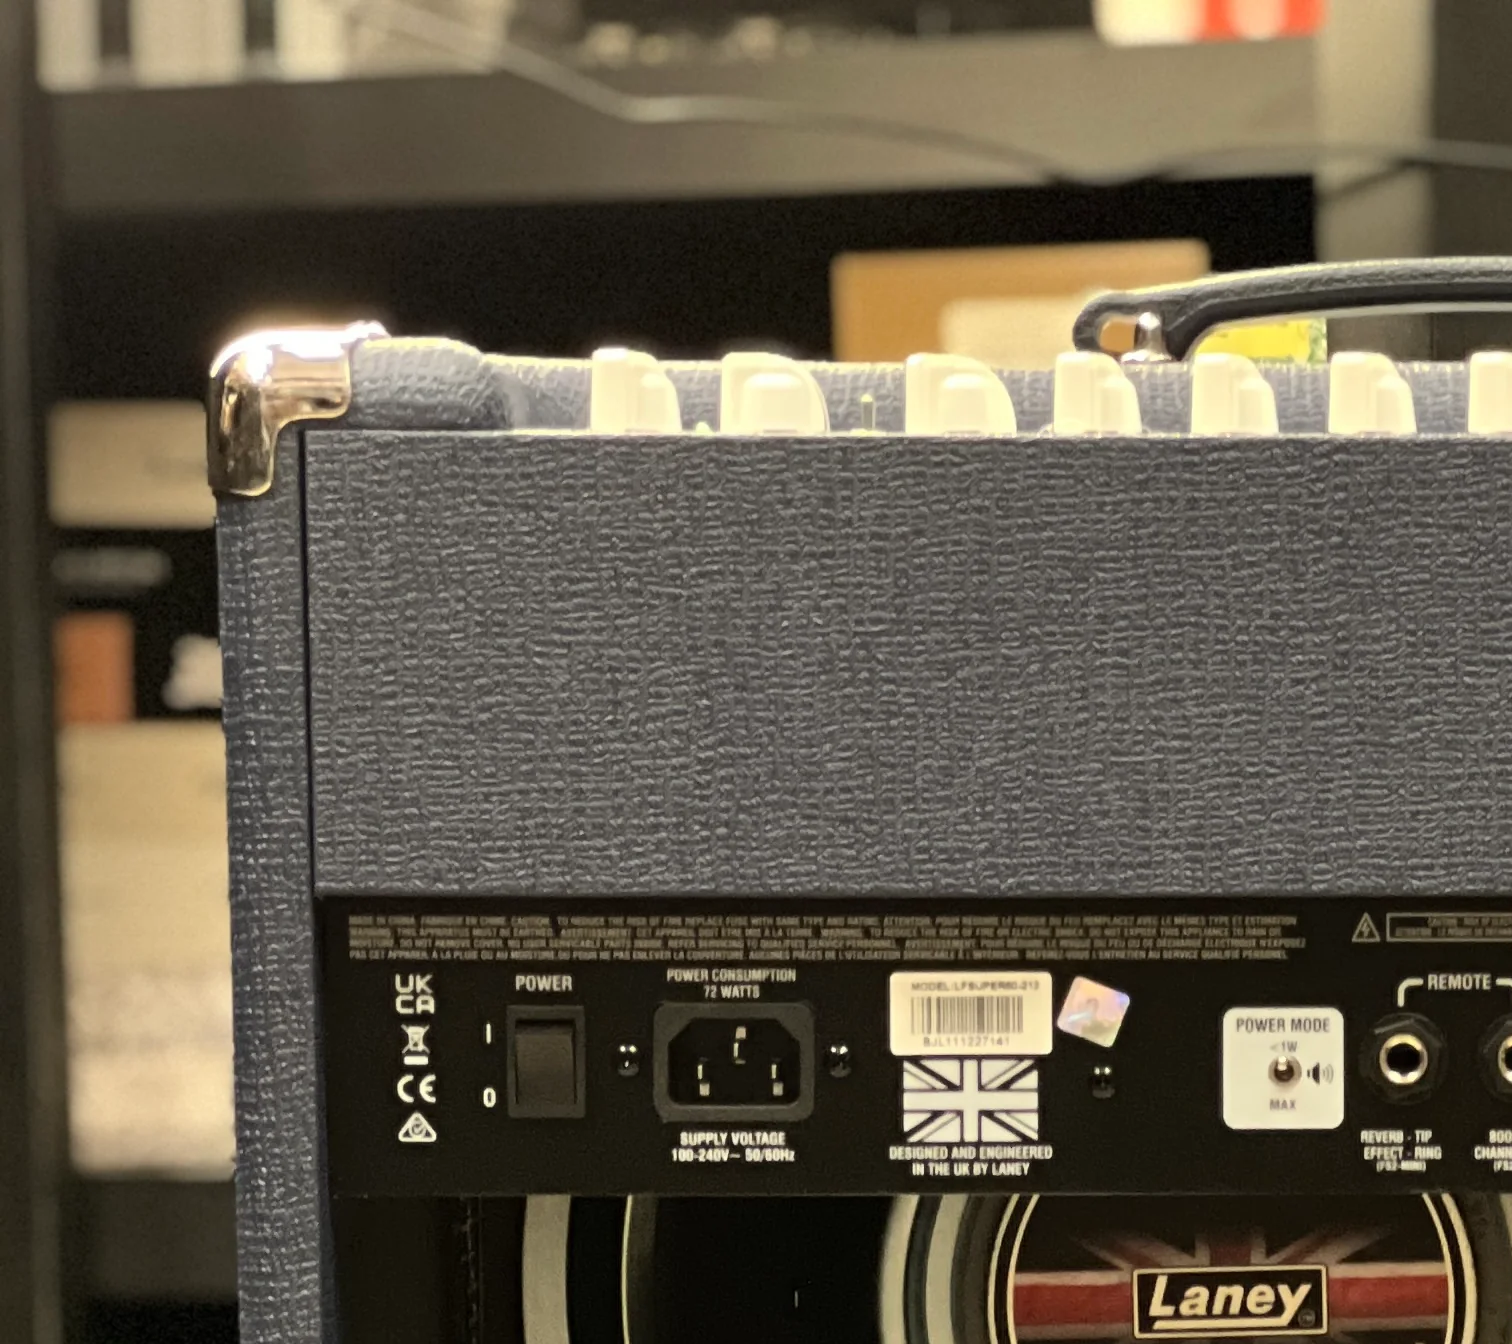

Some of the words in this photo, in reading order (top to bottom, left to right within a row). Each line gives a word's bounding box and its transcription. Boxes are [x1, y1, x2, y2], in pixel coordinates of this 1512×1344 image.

[667, 968, 709, 982] POWER
[711, 968, 797, 983] CONSUMPTION
[1427, 973, 1492, 991] REMOTE
[514, 974, 573, 993] POWER
[704, 985, 717, 999] 72
[720, 985, 761, 999] WATTS
[1236, 1017, 1286, 1033] POWER
[1290, 1017, 1331, 1033] MODE
[1269, 1099, 1297, 1111] MAX
[679, 1131, 730, 1147] SUPPLY
[732, 1131, 787, 1147] VOLTAGE
[1360, 1129, 1404, 1144] REVERB
[1415, 1129, 1433, 1144] TIP
[888, 1146, 948, 1160] DESIGNED
[950, 1146, 977, 1160] AND
[979, 1146, 1053, 1160] ENGINEERED
[1363, 1145, 1404, 1160] EFFECT
[1414, 1145, 1442, 1160] RING
[912, 1162, 925, 1176] IN
[928, 1162, 951, 1176] THE
[953, 1162, 970, 1176] UK
[973, 1162, 989, 1176] BY
[992, 1162, 1030, 1176] LANEY
[1148, 1274, 1312, 1331] Laney
